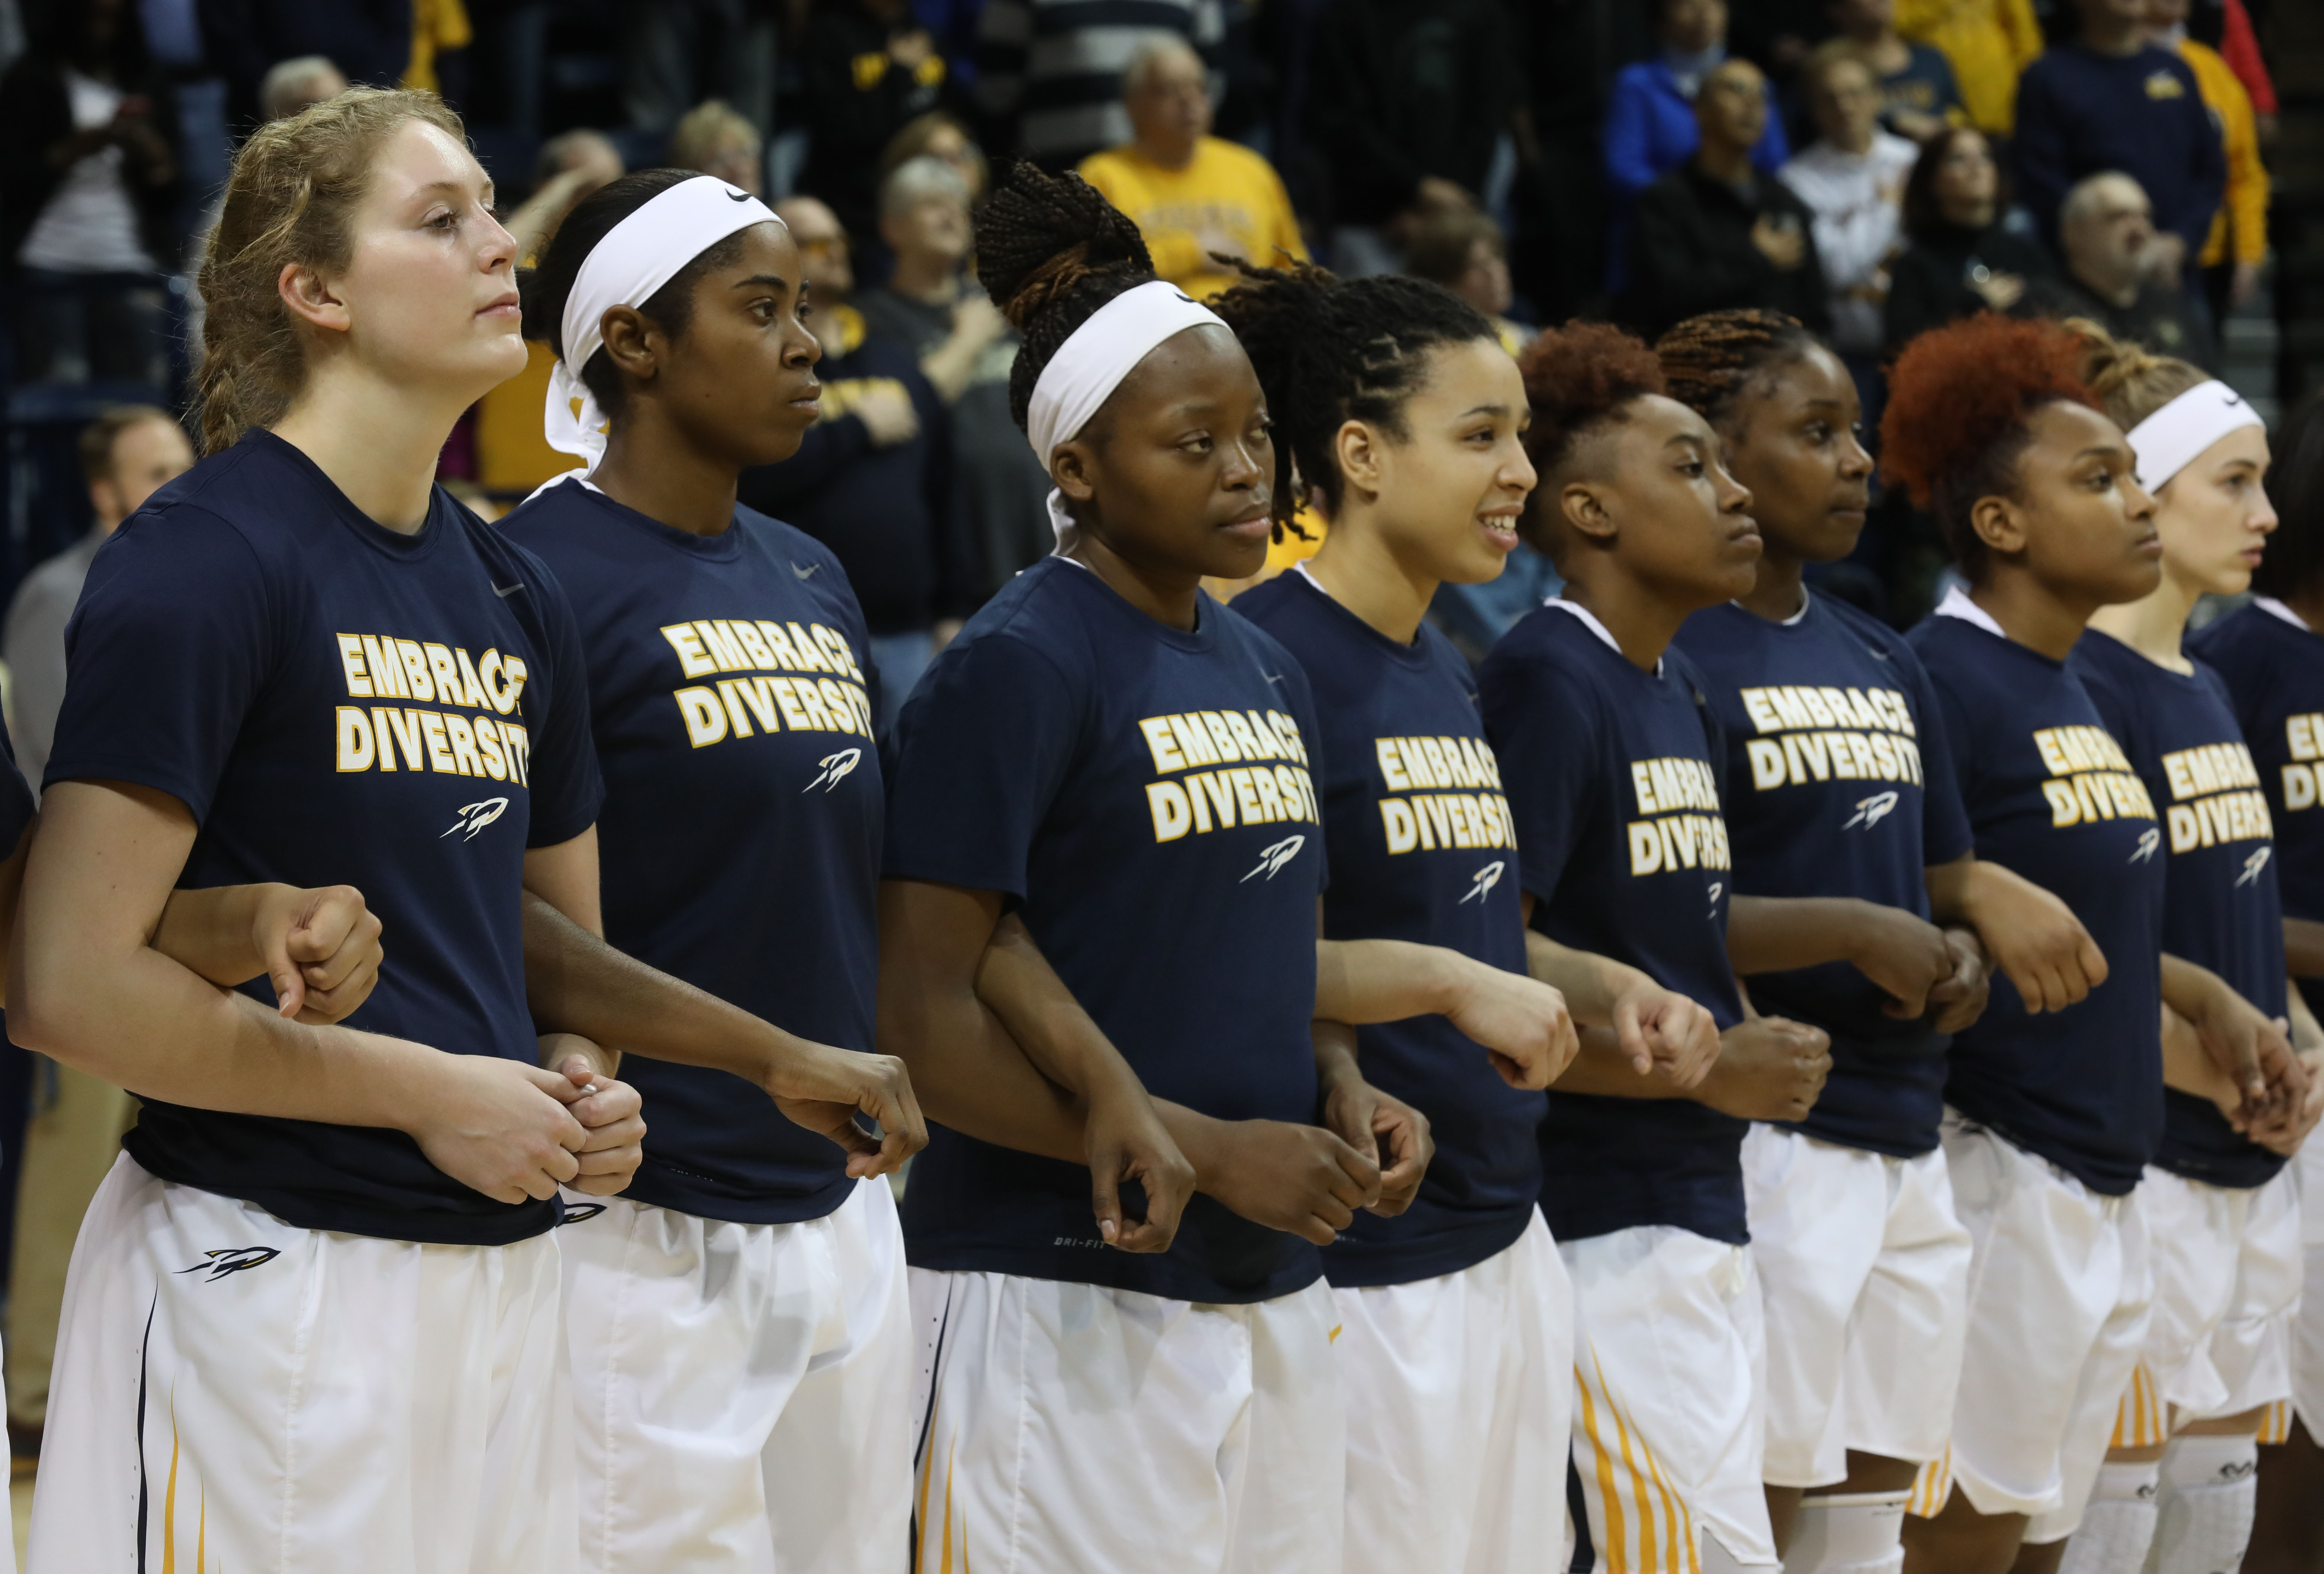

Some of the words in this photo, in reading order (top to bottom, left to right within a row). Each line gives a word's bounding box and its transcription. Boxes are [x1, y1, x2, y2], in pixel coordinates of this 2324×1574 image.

[660, 619, 865, 686] EMBRACE
[1740, 685, 1916, 738] EMBRACE
[336, 706, 530, 788] DIVERSIT
[1746, 731, 1924, 792] DIVERSIT
[1054, 1237, 1105, 1249] DRI-FIT
